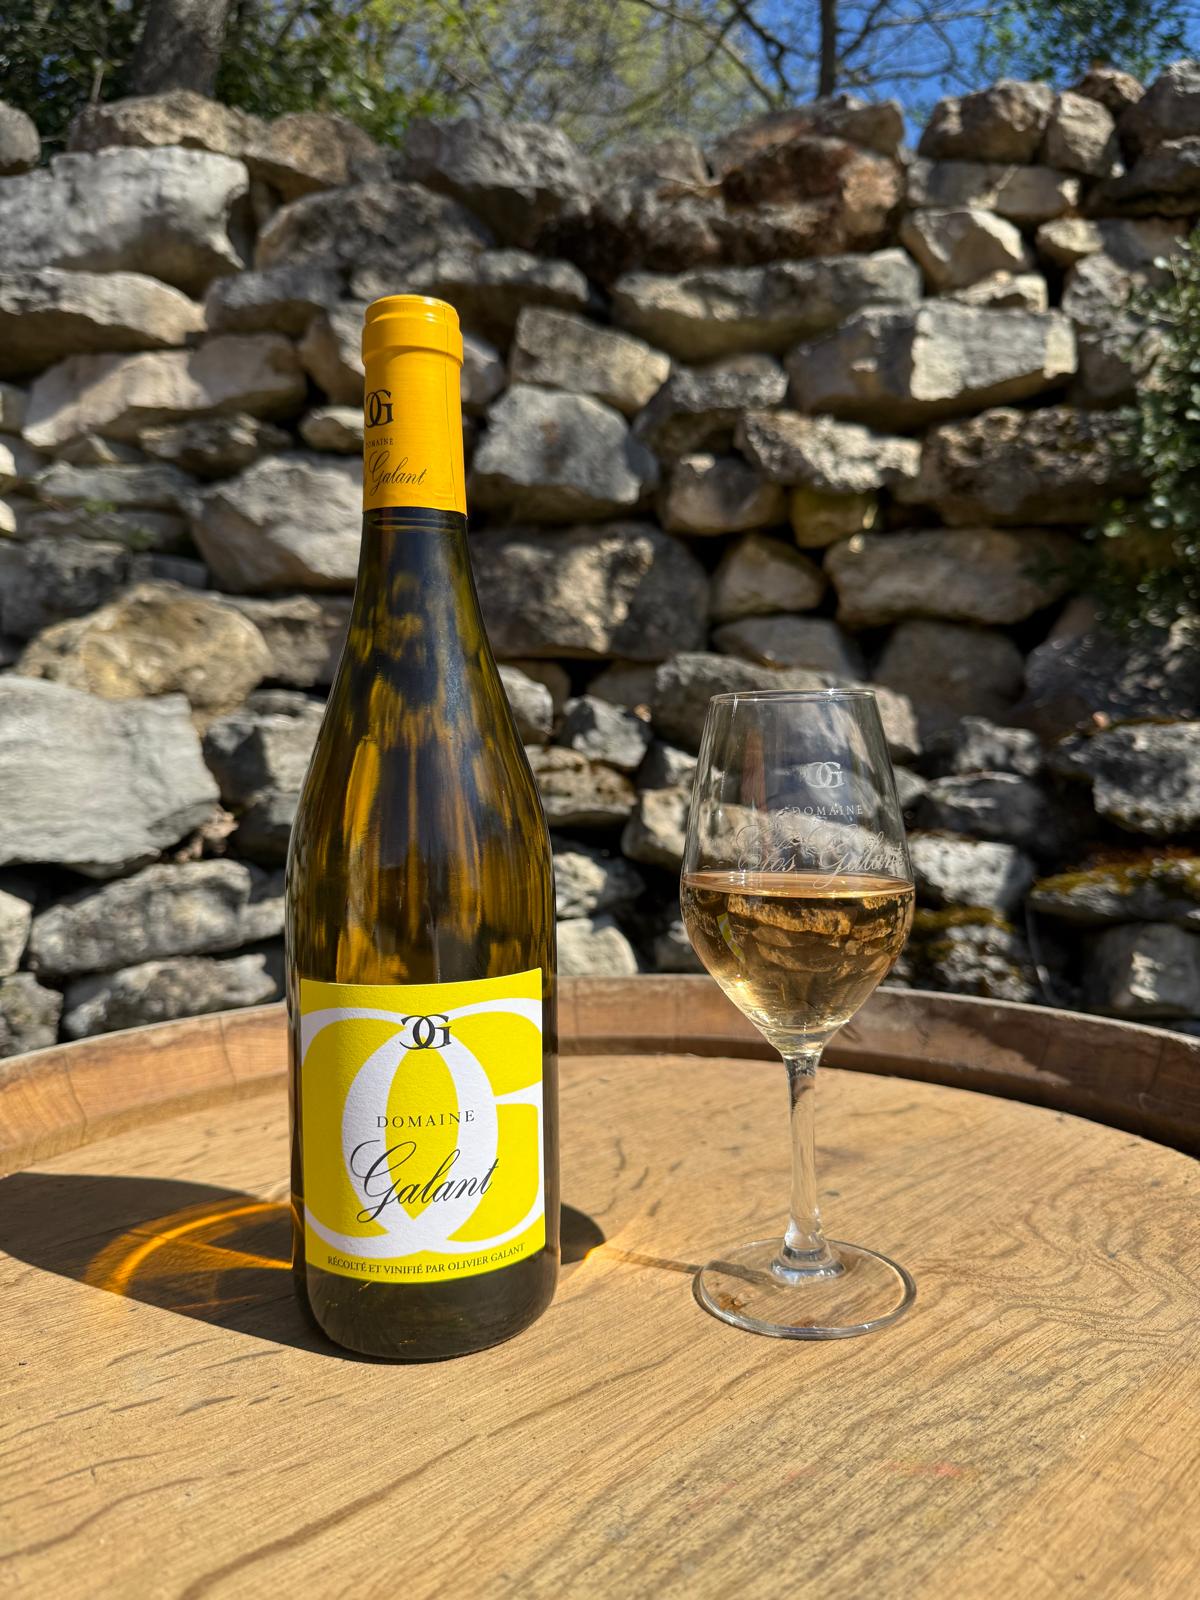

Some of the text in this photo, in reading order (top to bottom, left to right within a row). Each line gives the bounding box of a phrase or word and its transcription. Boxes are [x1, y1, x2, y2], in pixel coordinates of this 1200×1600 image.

[369, 450, 427, 497] Galant
[792, 804, 863, 816] DOMAINE
[376, 1110, 475, 1128] DOMAINE
[350, 1139, 499, 1223] Galant
[327, 1242, 526, 1274] RÉCOLTÉ ET VINIFIÉ PAR OLIVIER GALANT
